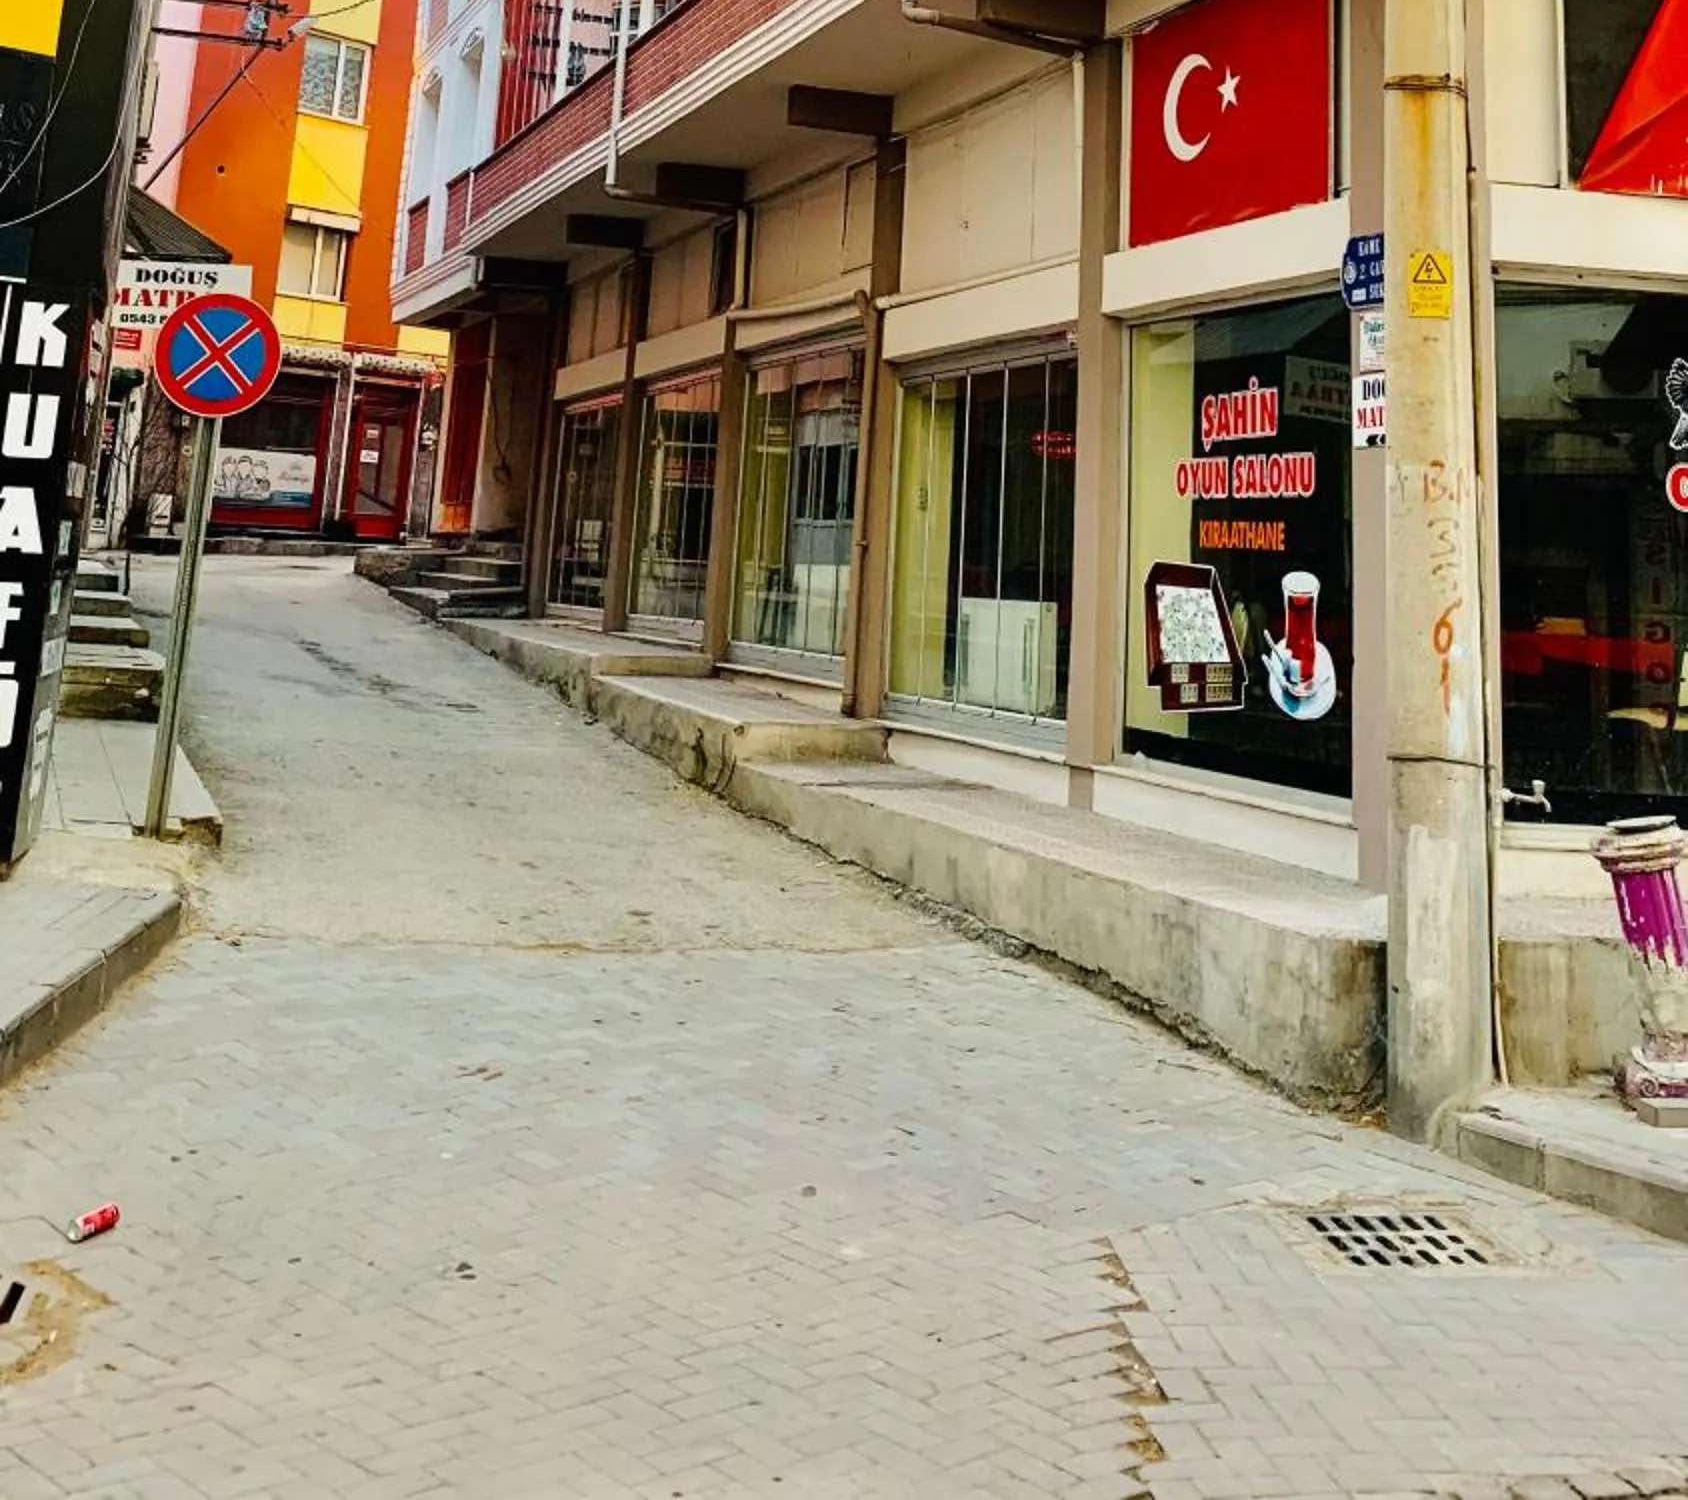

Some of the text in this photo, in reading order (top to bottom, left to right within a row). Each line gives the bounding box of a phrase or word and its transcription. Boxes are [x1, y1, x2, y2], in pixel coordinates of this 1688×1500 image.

[135, 268, 218, 288] DOĞUŞ
[120, 313, 156, 324] 0543
[1201, 376, 1278, 452] ŞAHİN
[1175, 452, 1314, 500] OYUN SALONU
[1200, 520, 1285, 550] KIRAATHANE
